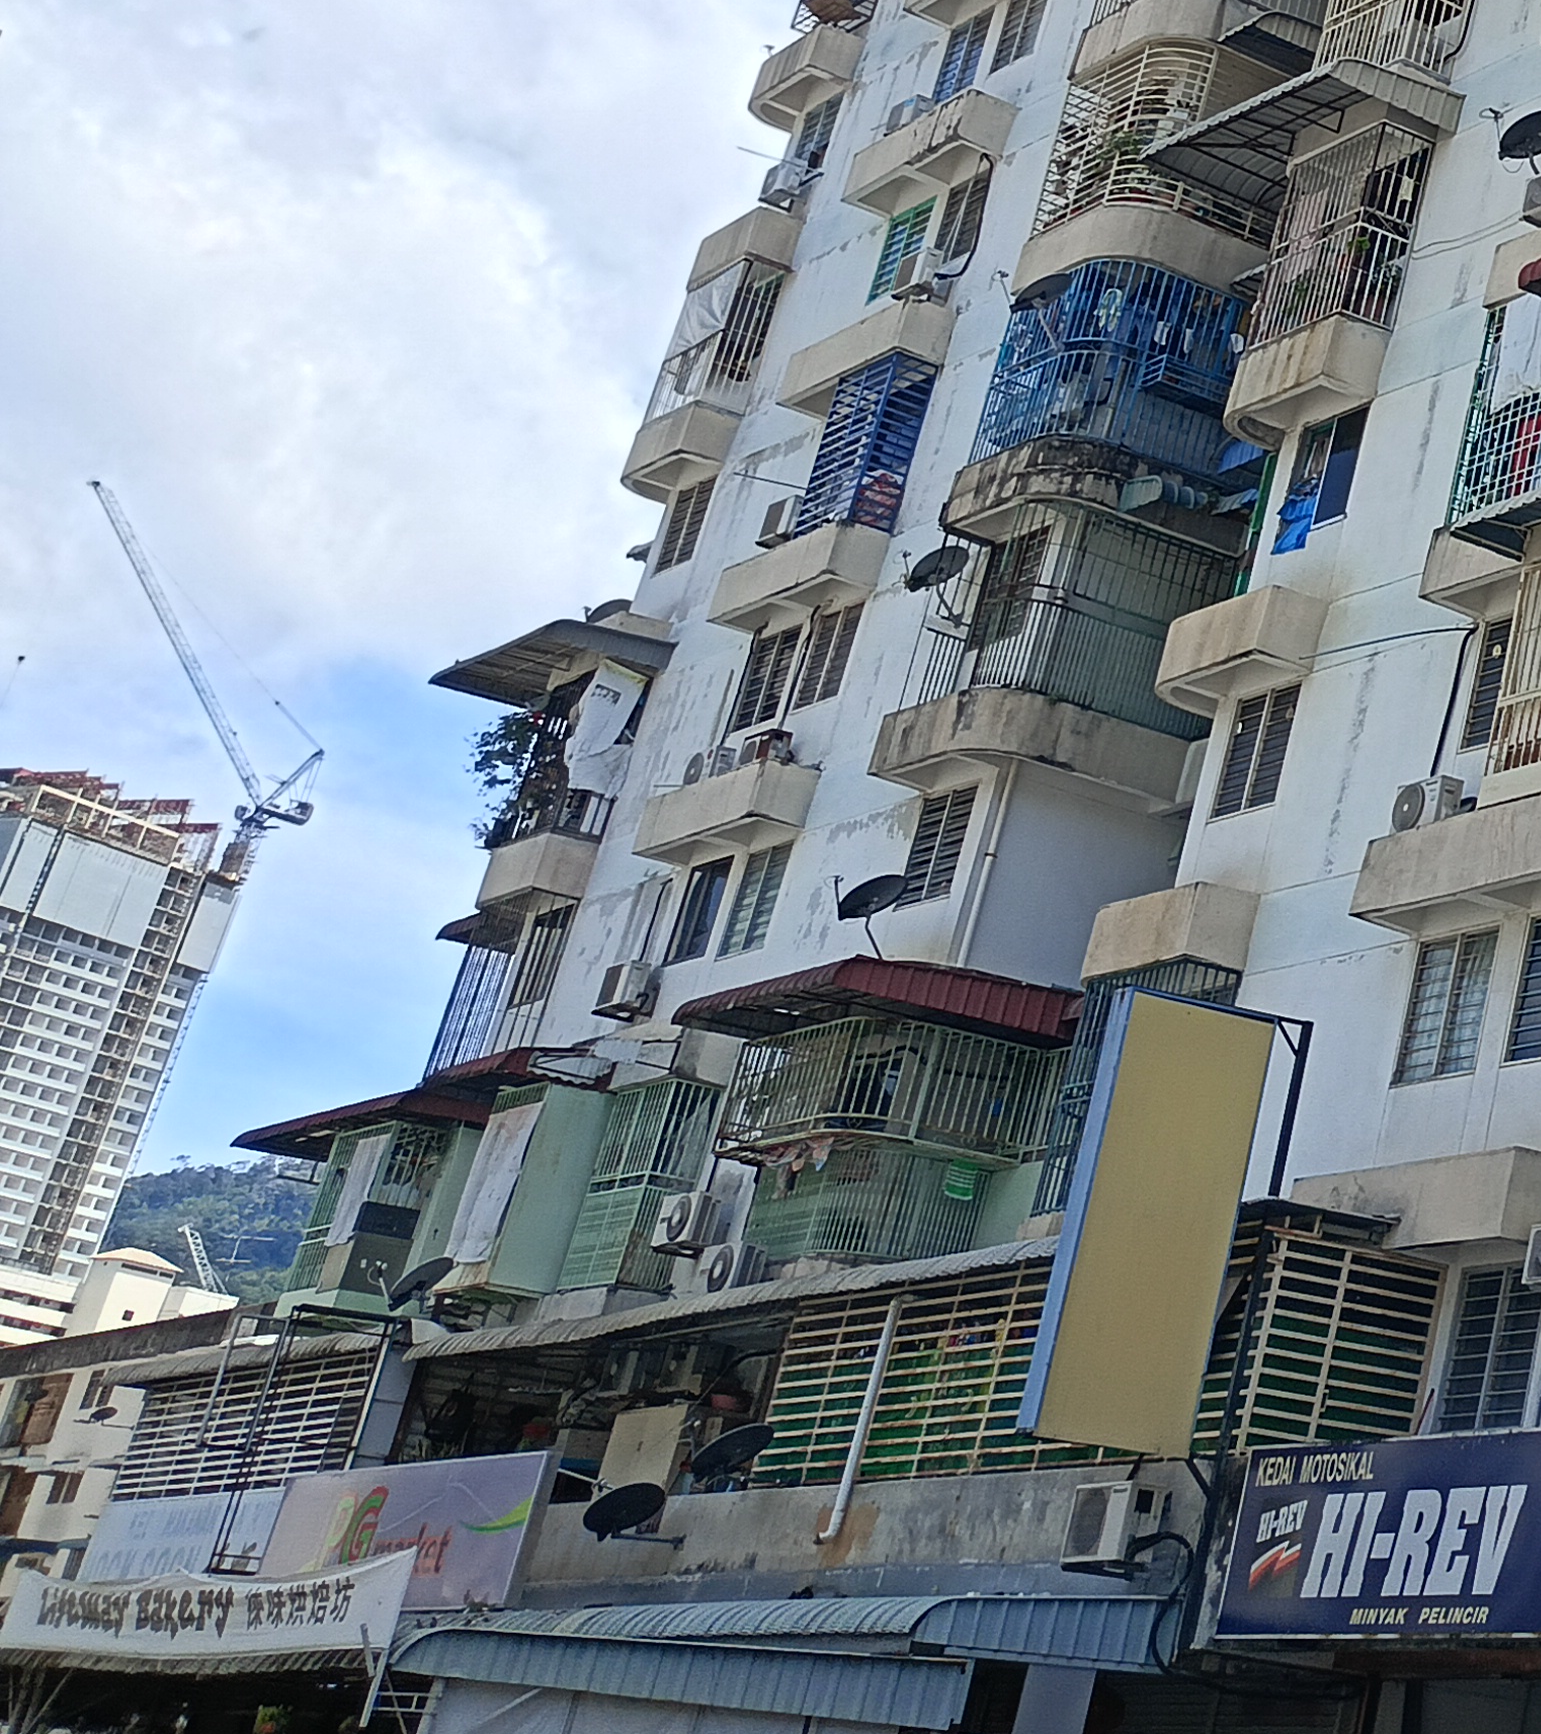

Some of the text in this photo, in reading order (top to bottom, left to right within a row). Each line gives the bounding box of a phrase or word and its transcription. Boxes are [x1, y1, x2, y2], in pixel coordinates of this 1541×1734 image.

[1255, 1451, 1374, 1487] KEDAI MOTOSIKAL
[1256, 1499, 1309, 1544] HI-REV
[1300, 1484, 1528, 1598] HI-REV
[1349, 1606, 1490, 1625] MINYAK PELINCIR
